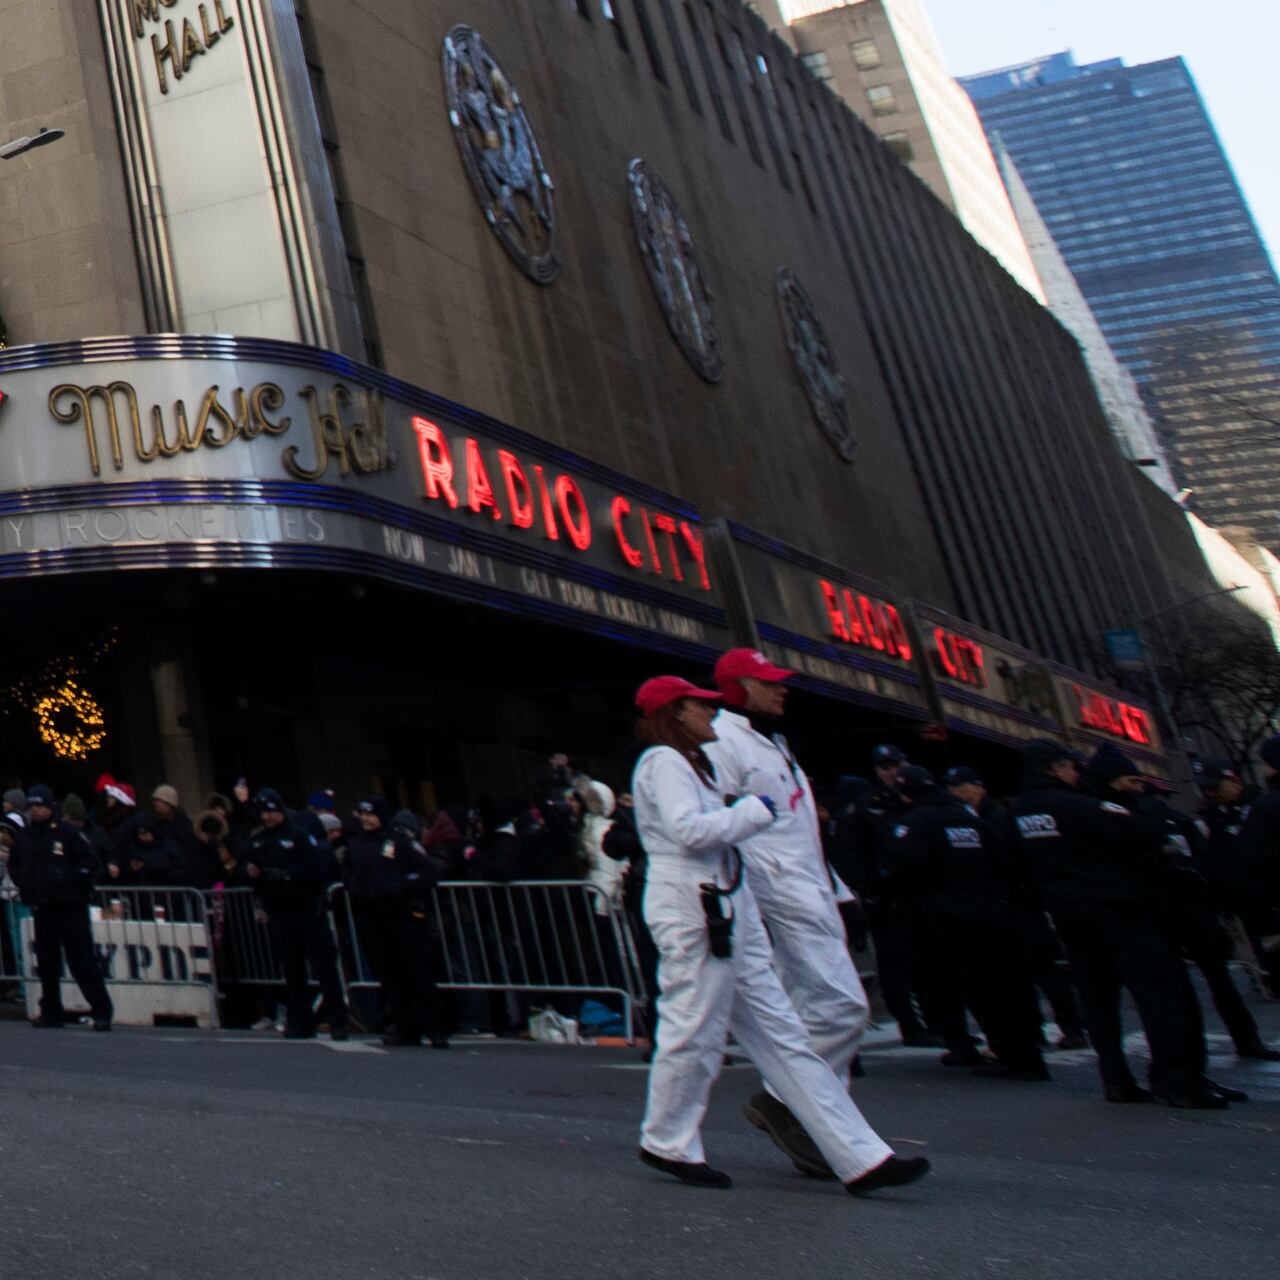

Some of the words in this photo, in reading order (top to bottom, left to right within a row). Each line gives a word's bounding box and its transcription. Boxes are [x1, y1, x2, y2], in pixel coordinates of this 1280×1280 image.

[48, 380, 292, 477] Music
[412, 415, 592, 551] RADIO
[611, 495, 711, 592] CITY
[62, 505, 325, 544] ROCKETTES
[383, 525, 425, 564] NOW
[80, 942, 190, 981] YPD
